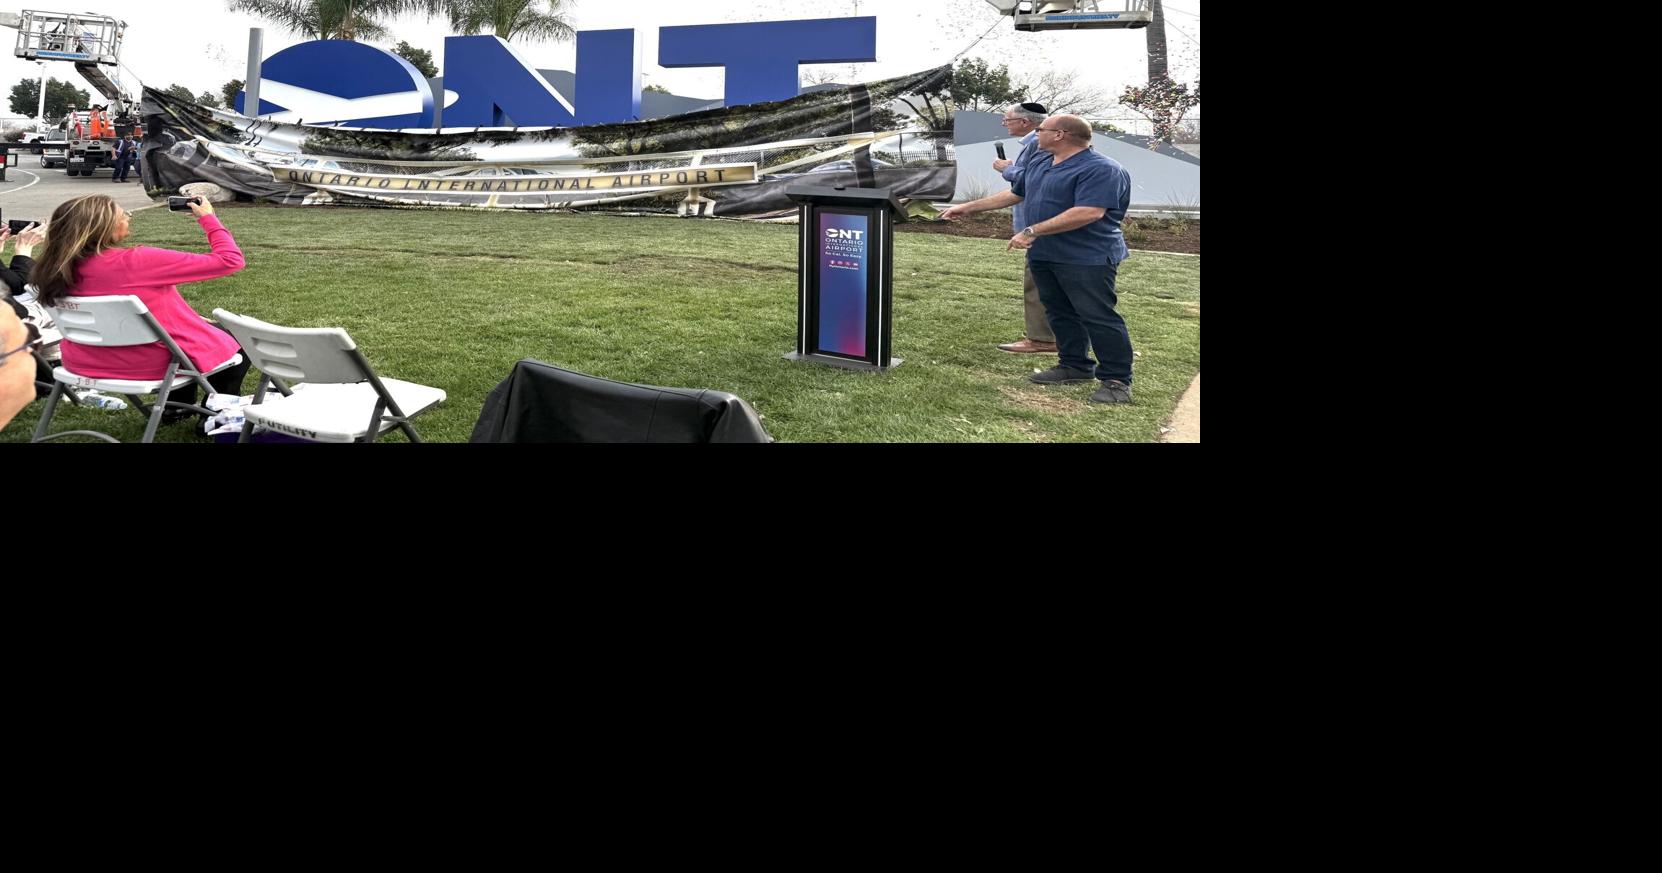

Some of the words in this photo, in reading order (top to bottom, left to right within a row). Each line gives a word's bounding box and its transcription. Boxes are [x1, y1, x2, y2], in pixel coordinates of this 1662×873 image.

[234, 16, 877, 129] ONT
[288, 169, 391, 190] ONTARIO
[403, 177, 594, 192] INTERNATIONAL
[611, 169, 726, 188] AIRPORT
[825, 228, 864, 240] ONT
[825, 237, 864, 246] ONTARIO
[825, 245, 863, 253] AIRPORT
[267, 420, 317, 439] UTILITY
